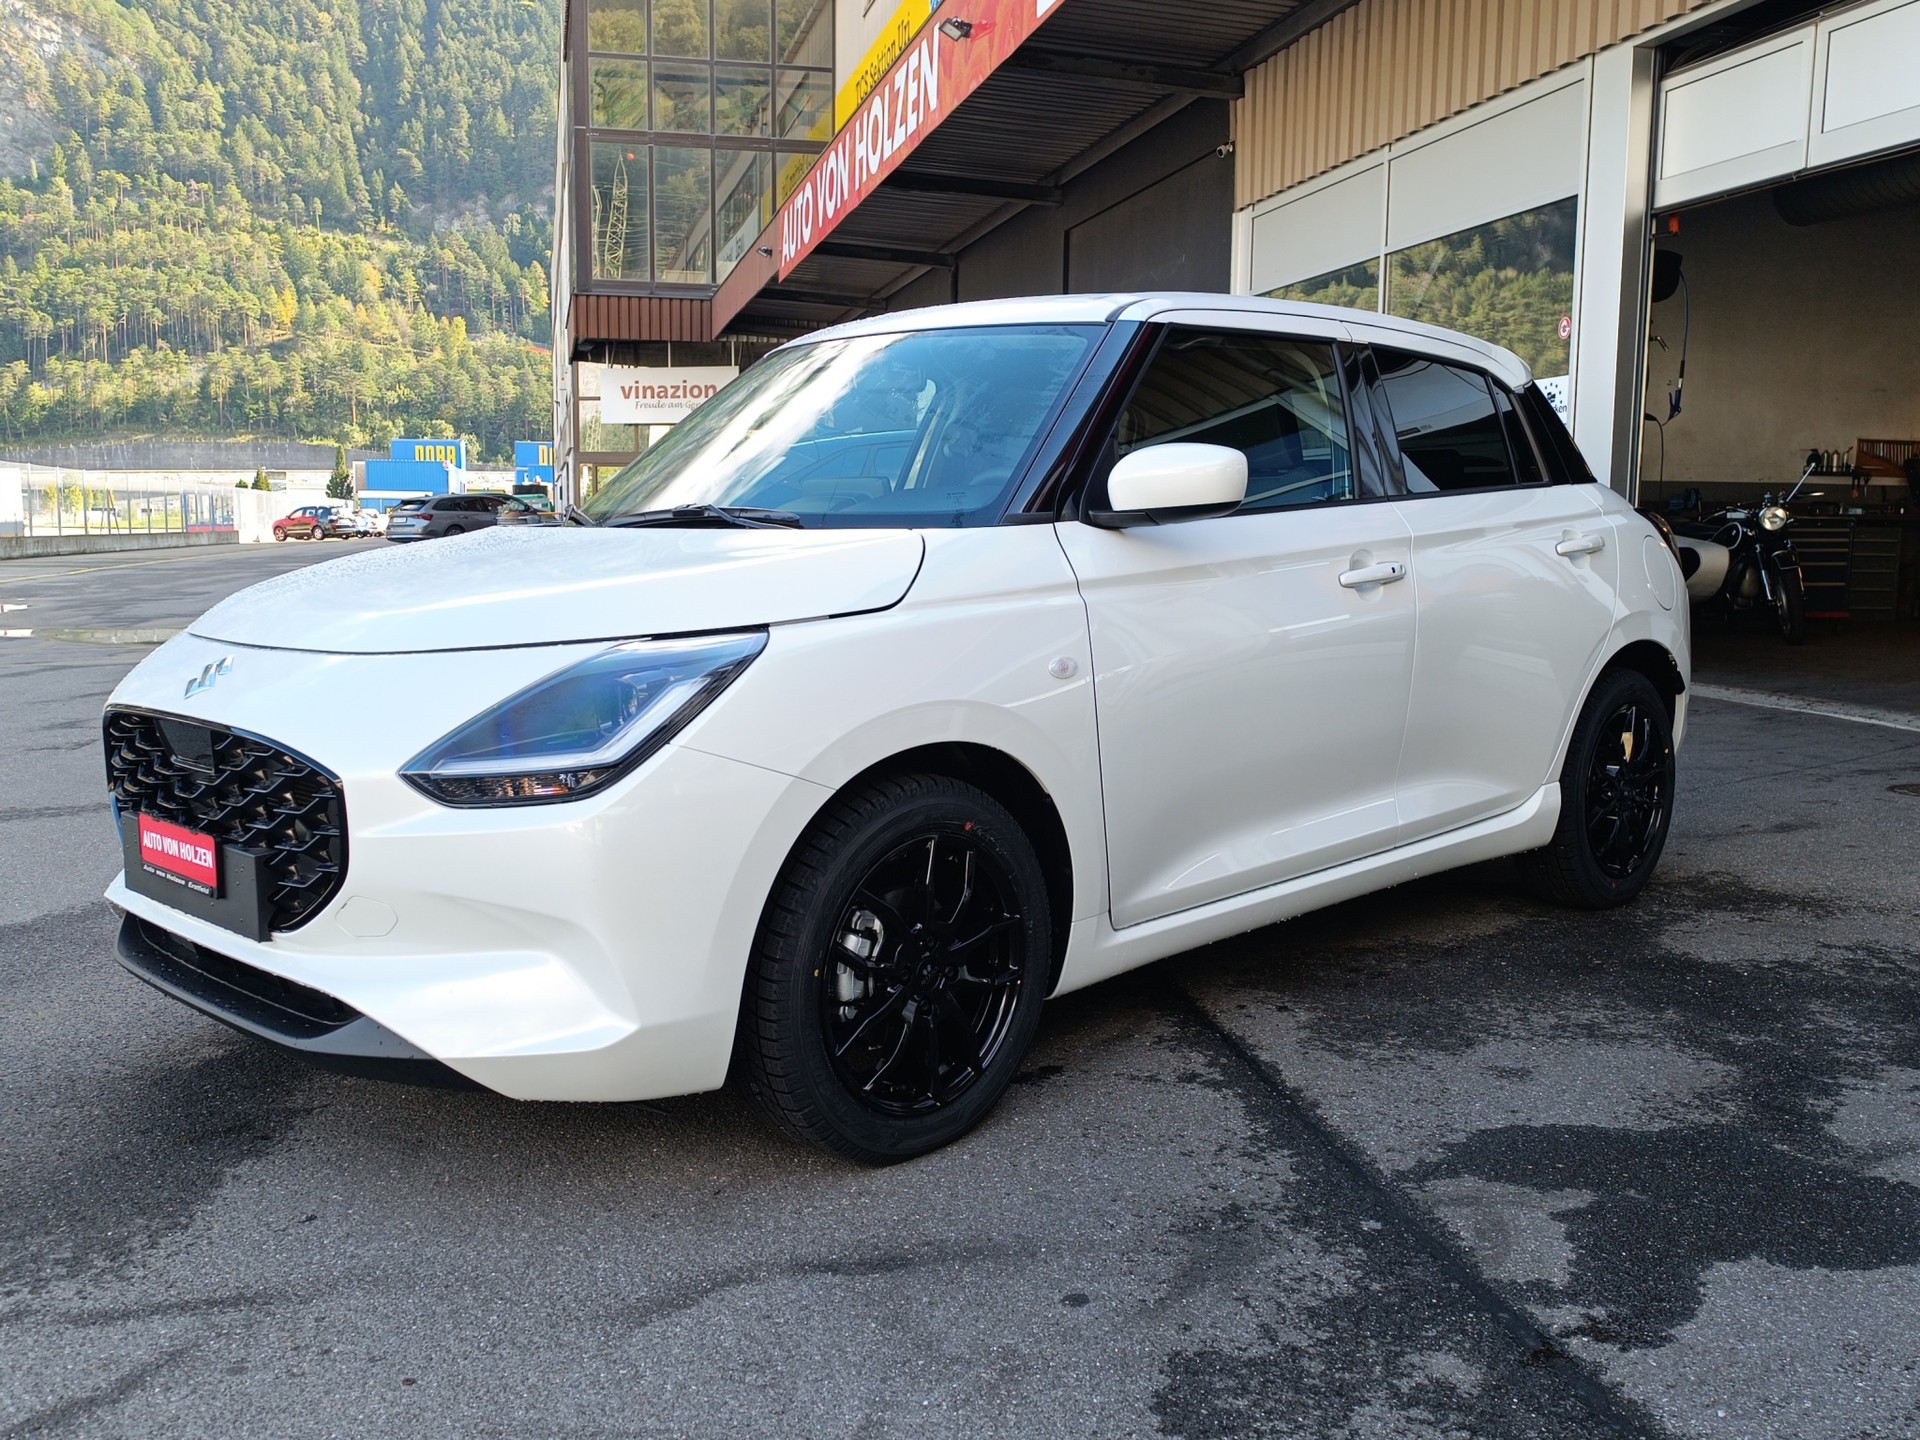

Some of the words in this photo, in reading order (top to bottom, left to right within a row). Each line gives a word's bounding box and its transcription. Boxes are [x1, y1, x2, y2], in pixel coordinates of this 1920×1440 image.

[781, 181, 813, 267] AUTO
[816, 131, 850, 229] VON
[855, 21, 940, 192] HOLZEN
[620, 380, 718, 400] vinazion
[635, 400, 667, 411] Freude
[667, 401, 683, 410] am
[143, 830, 163, 852] AUTO
[162, 836, 180, 858] VON
[179, 841, 213, 869] HOLZEN
